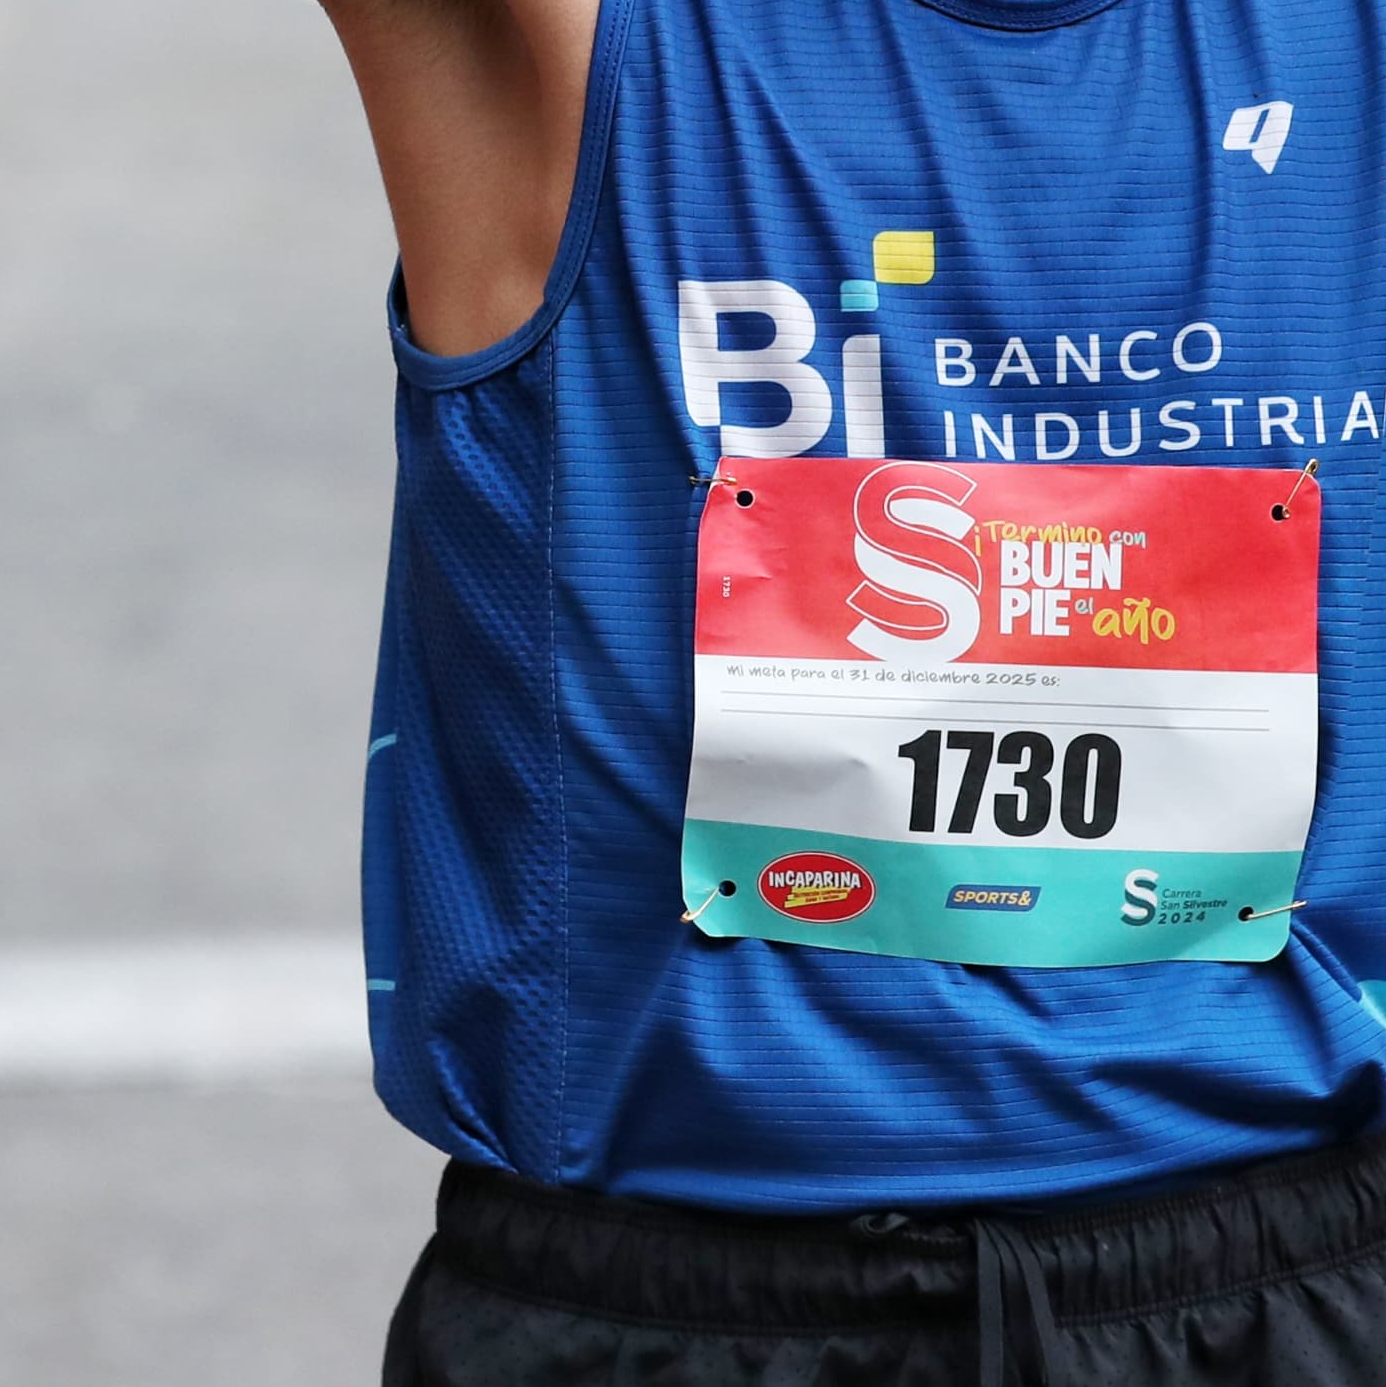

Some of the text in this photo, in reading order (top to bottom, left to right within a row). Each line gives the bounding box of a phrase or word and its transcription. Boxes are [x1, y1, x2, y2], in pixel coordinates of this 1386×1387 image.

[934, 321, 1223, 387] BANCO
[678, 280, 886, 458] Bi
[1108, 529, 1147, 550] con
[999, 539, 1123, 591] BUEN
[999, 588, 1177, 645] PIE el año
[726, 664, 1061, 687] mi meta para el 31 de diciembre 2025 es:
[897, 729, 1123, 840] 1730
[768, 870, 862, 889] INCAPARINA
[953, 890, 1032, 906] SPORTS&
[1162, 888, 1202, 899] Carrera
[1160, 899, 1228, 911] San Silvestre
[1158, 911, 1207, 925] 2024
